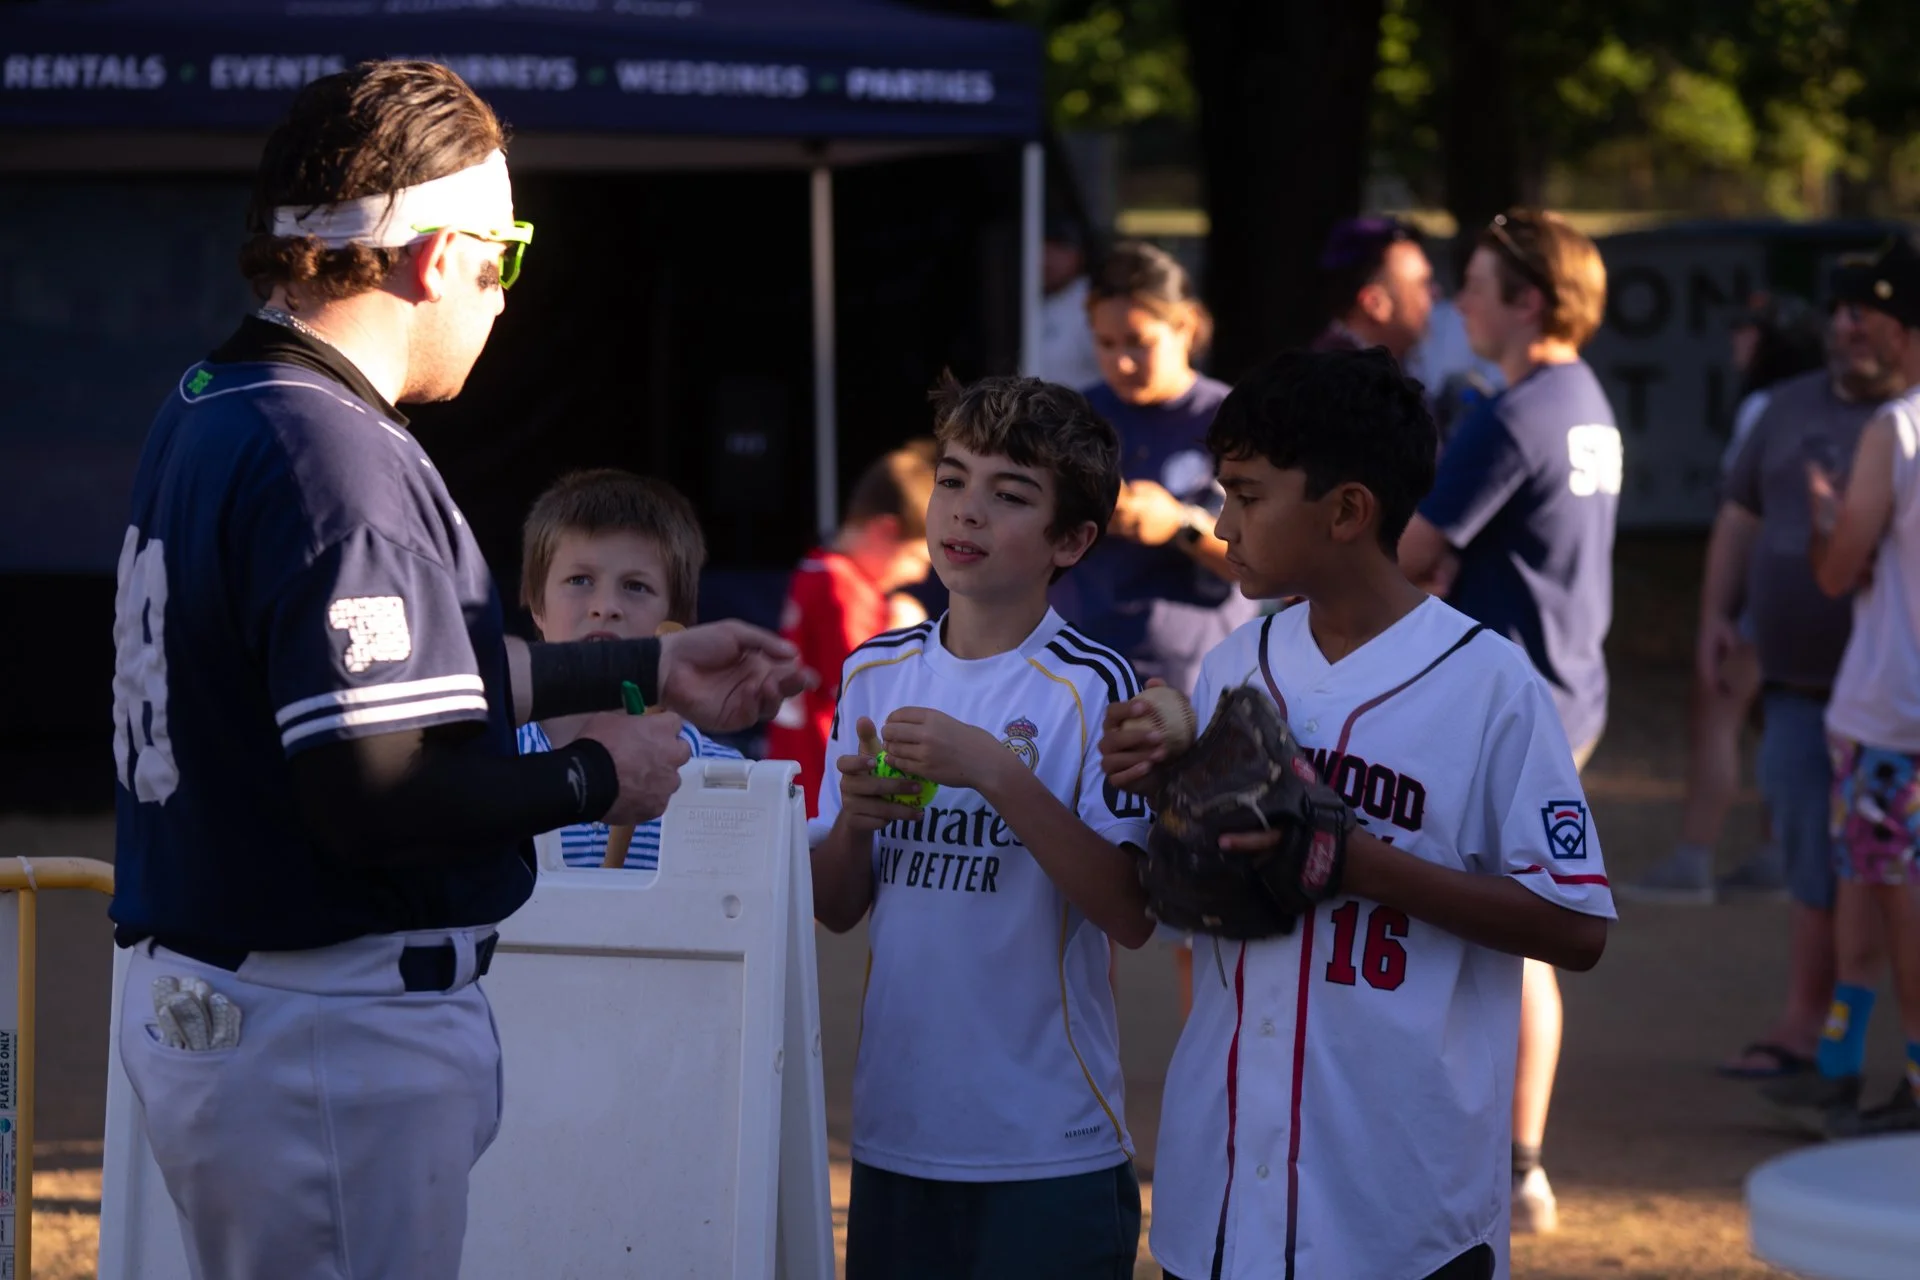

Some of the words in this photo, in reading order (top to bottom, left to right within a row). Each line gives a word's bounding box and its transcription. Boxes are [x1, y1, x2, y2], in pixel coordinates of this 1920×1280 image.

[3, 54, 166, 90] RENTALS
[614, 59, 808, 97] WEDDINGS
[845, 67, 995, 104] PARTIES
[906, 851, 1000, 893] BETTER
[1325, 901, 1410, 992] 16
[0, 1031, 10, 1060] ONLY
[0, 1062, 10, 1110] PLAYERS
